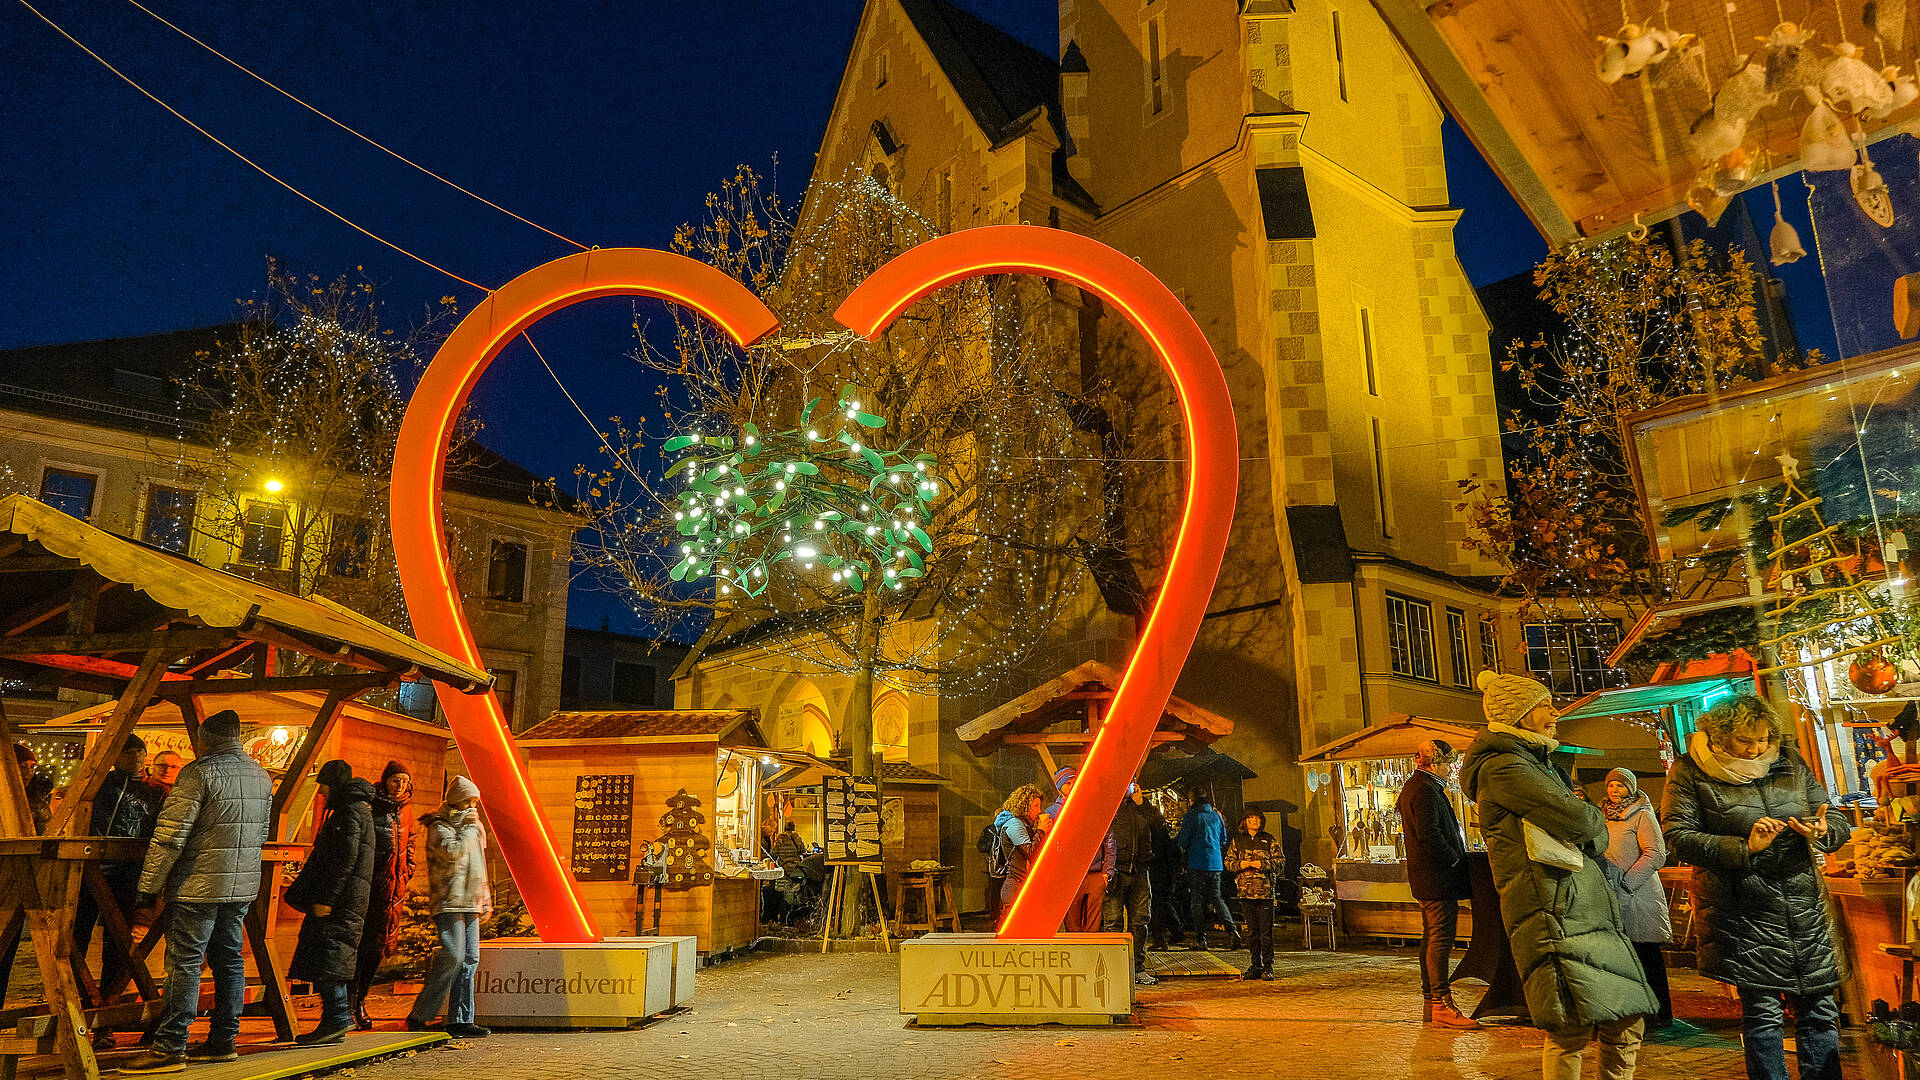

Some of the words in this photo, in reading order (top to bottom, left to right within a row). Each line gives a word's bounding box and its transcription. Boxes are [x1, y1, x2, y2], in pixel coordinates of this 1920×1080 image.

[959, 950, 1072, 968] VILLACHER
[474, 970, 637, 994] llacheradvent
[917, 973, 1087, 1009] ADVENT
